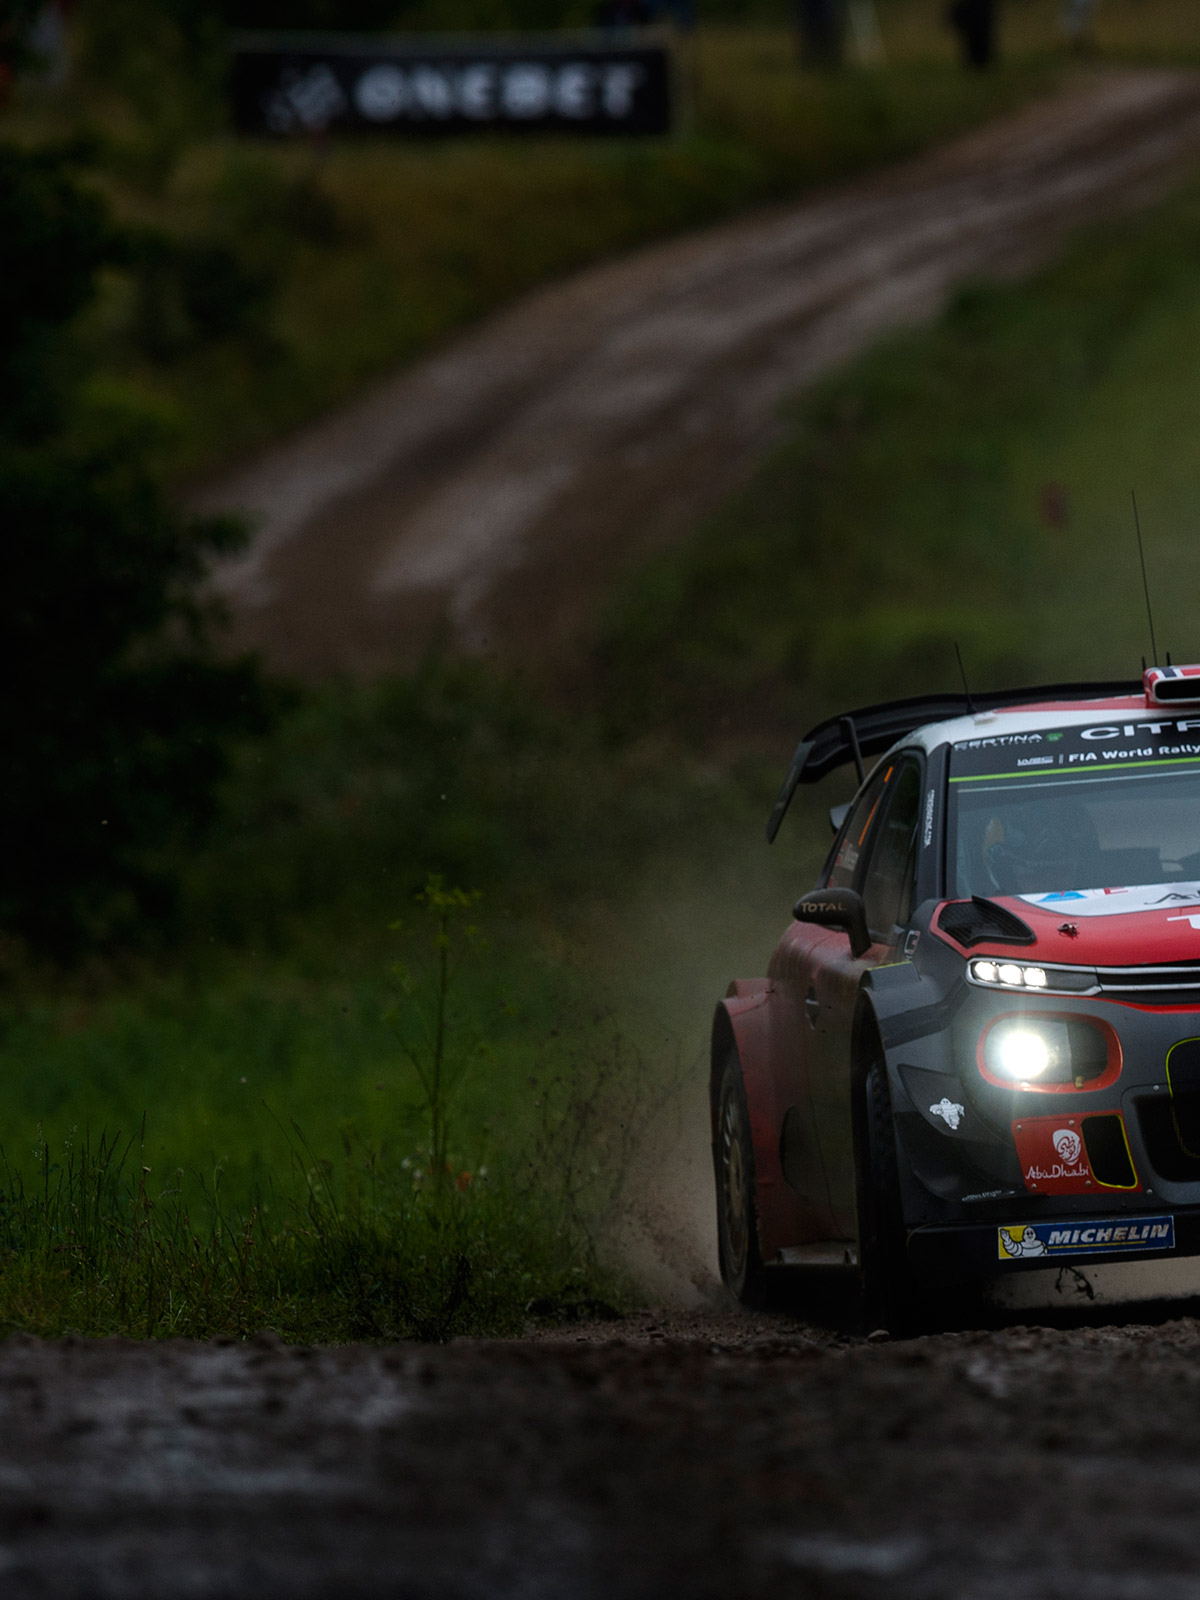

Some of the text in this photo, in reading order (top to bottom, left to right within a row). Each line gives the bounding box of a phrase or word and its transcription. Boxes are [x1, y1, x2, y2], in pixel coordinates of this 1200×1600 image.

[1068, 751, 1098, 764] FIA
[1102, 746, 1154, 760] World
[801, 902, 848, 913] TOTAL
[1048, 1223, 1170, 1246] MICHELIN
